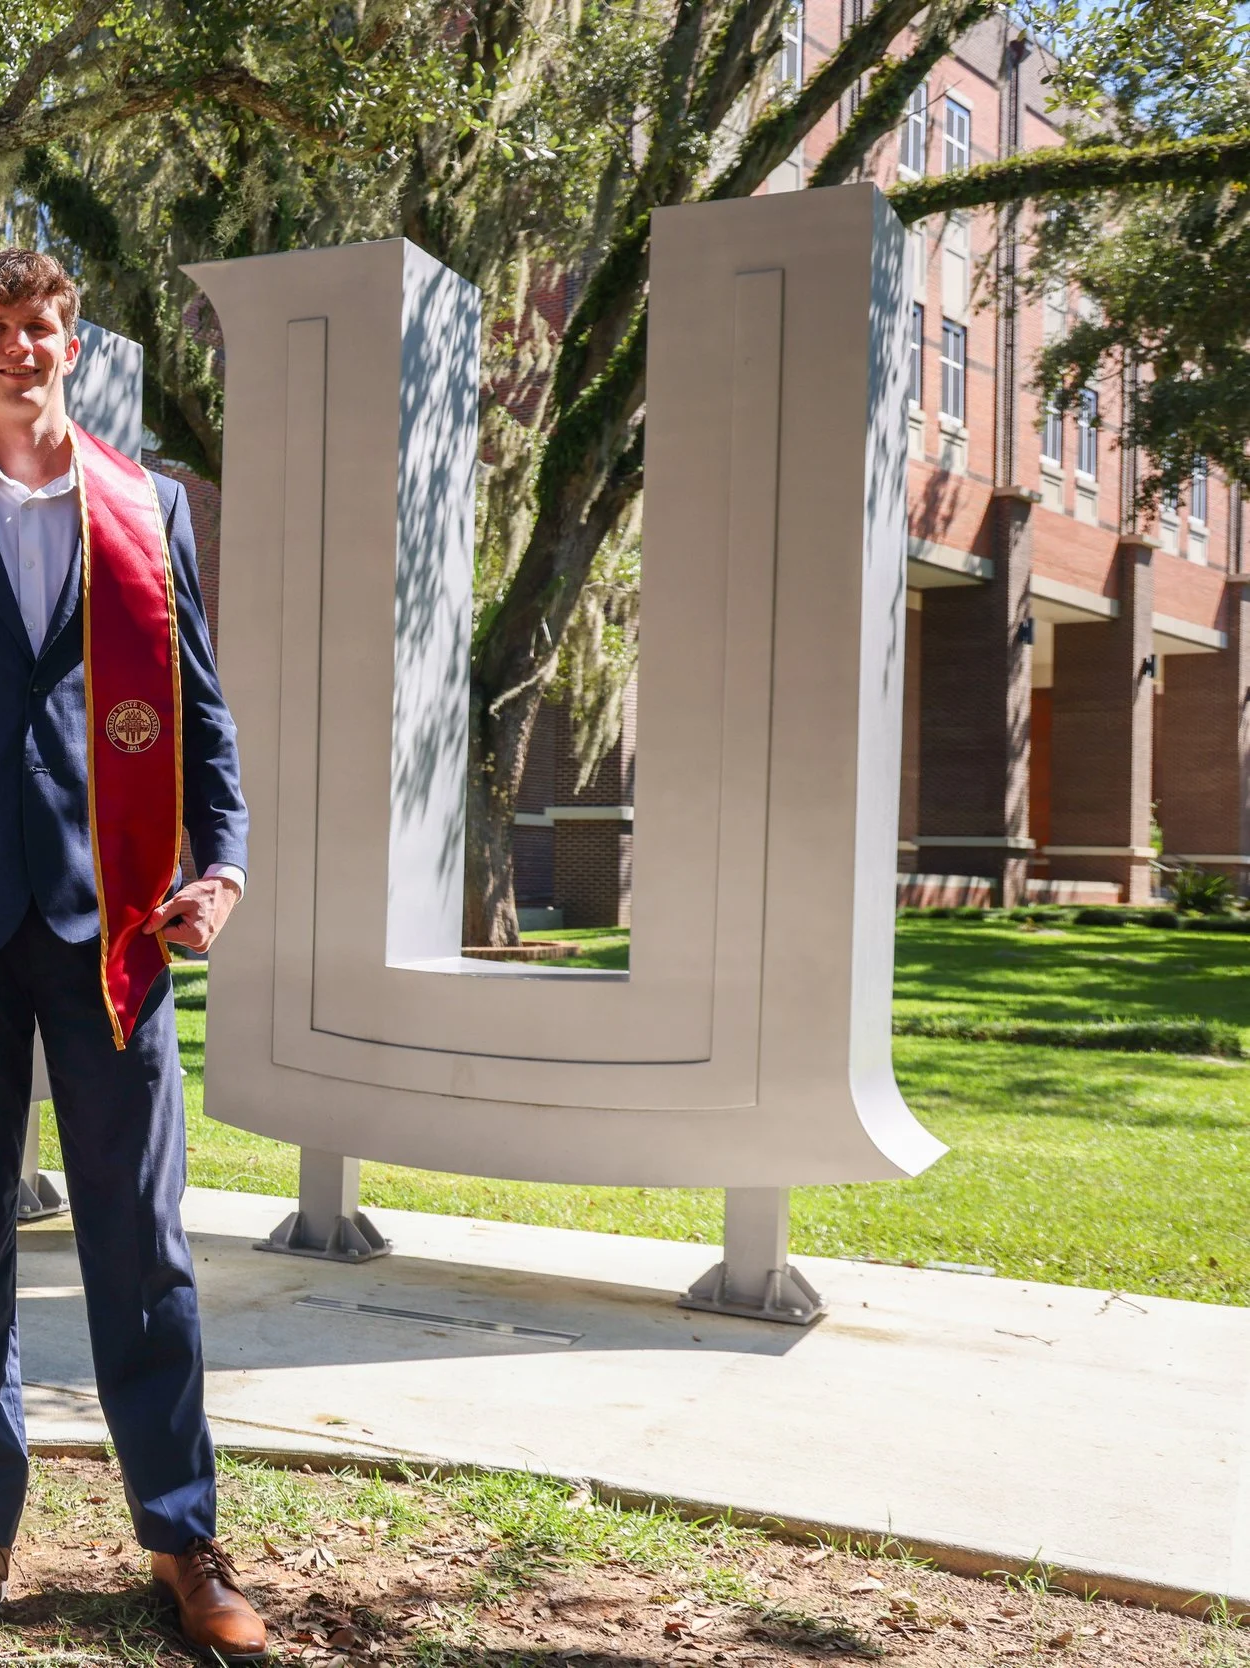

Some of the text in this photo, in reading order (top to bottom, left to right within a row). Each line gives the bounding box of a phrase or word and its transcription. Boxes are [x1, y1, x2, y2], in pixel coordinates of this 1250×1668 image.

[109, 702, 158, 741] FLORIDA STATE UNIVERSITY
